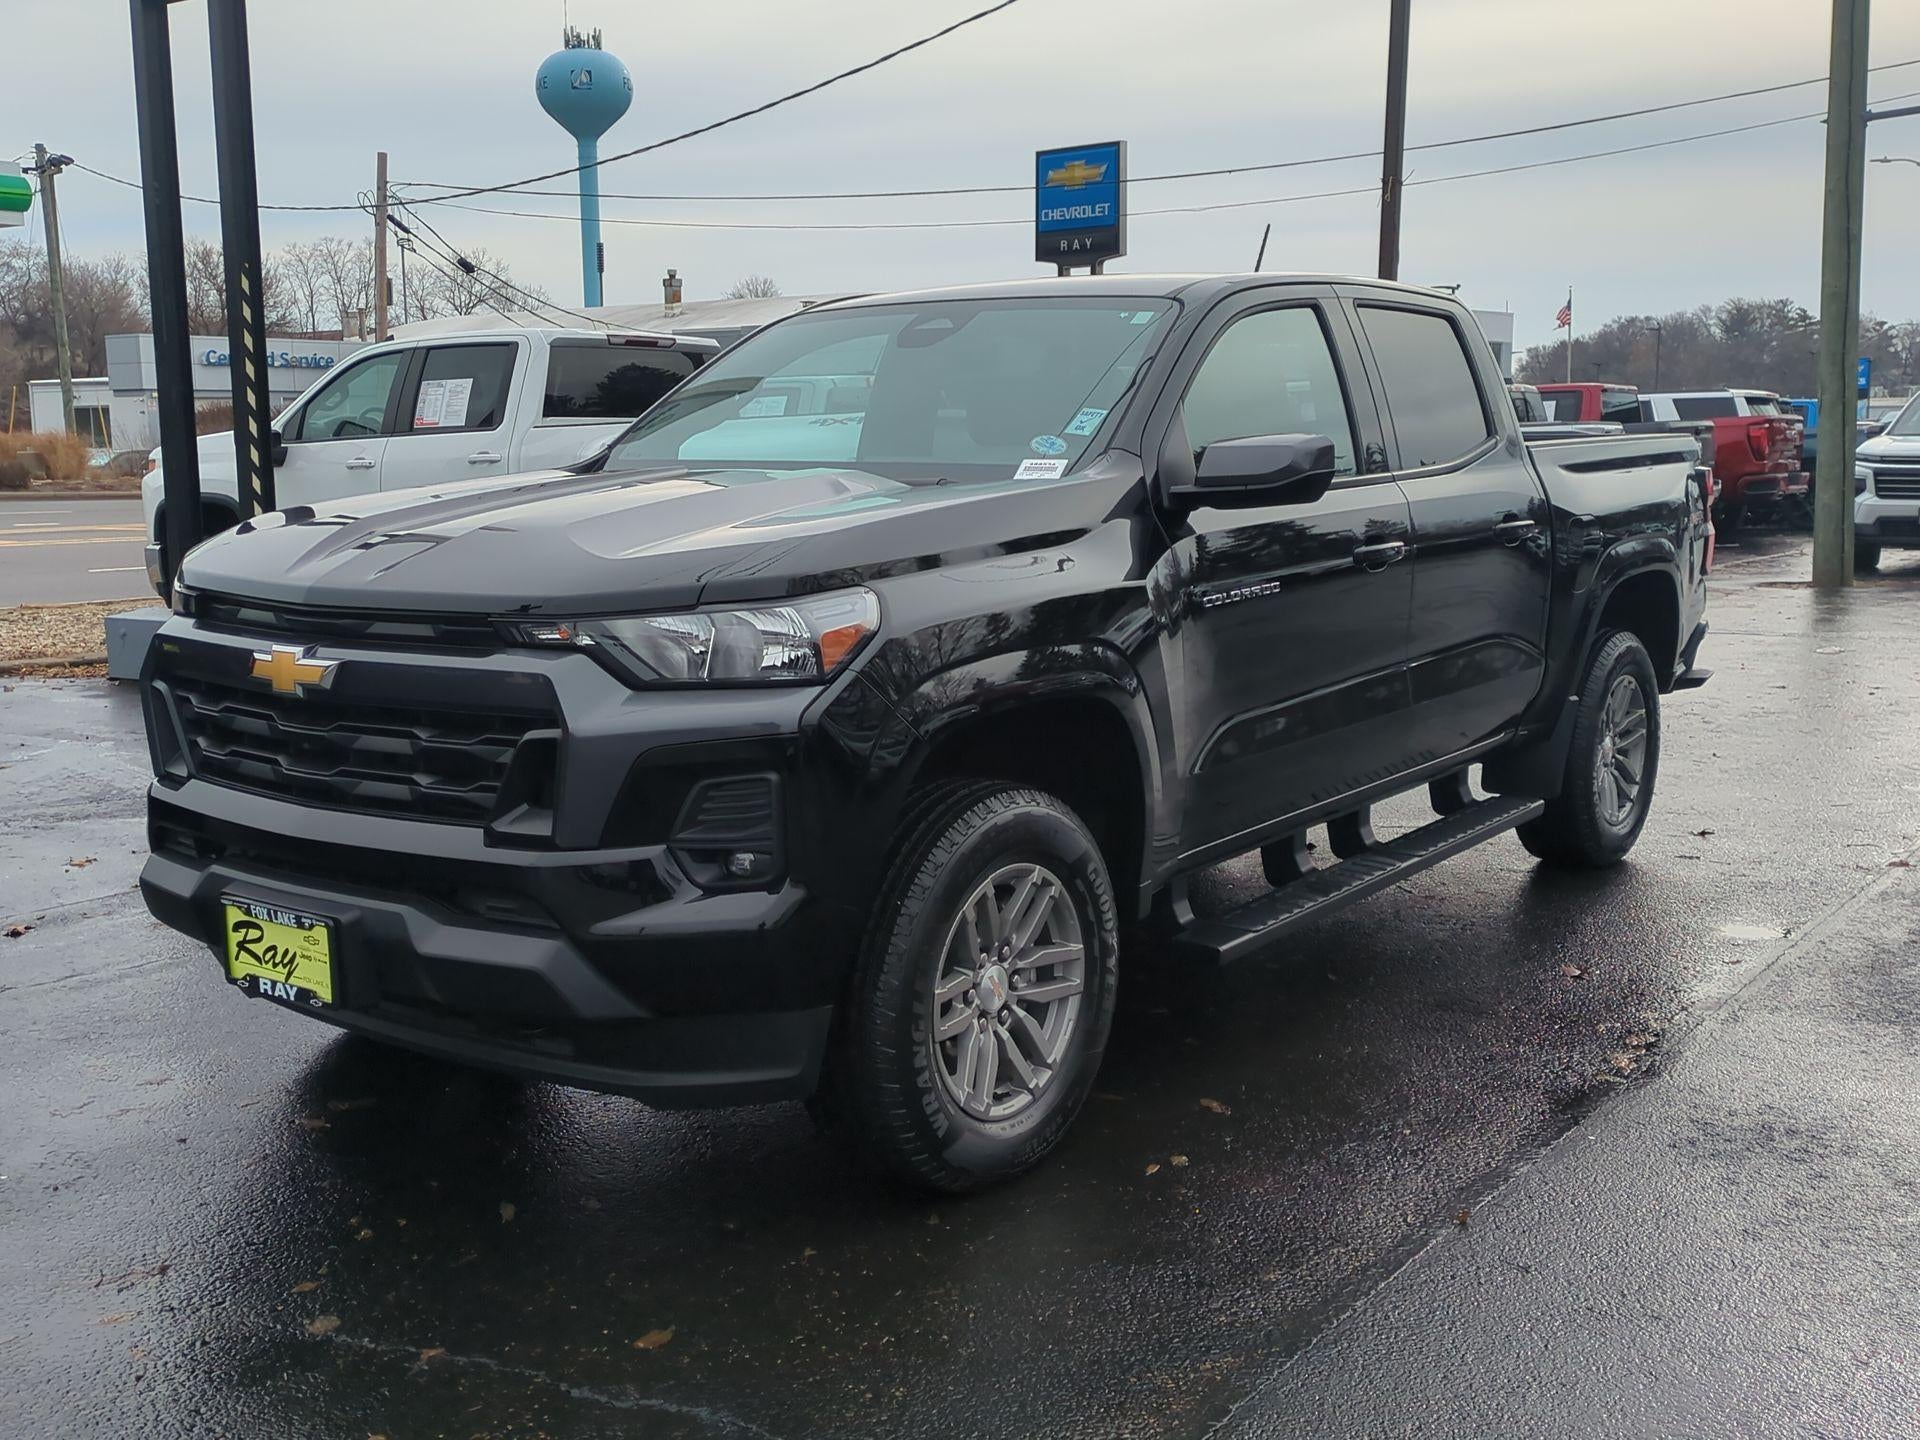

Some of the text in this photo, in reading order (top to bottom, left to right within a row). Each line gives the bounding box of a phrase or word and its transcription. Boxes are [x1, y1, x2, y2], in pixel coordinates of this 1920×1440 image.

[1041, 203, 1111, 221] CHEVROLET
[1060, 237, 1092, 251] RAY
[280, 351, 335, 368] Service
[1203, 581, 1280, 607] COLORADO
[250, 904, 270, 922] FOX
[271, 909, 298, 929] LAKE
[231, 920, 299, 983] Ray
[259, 978, 298, 1001] RAY
